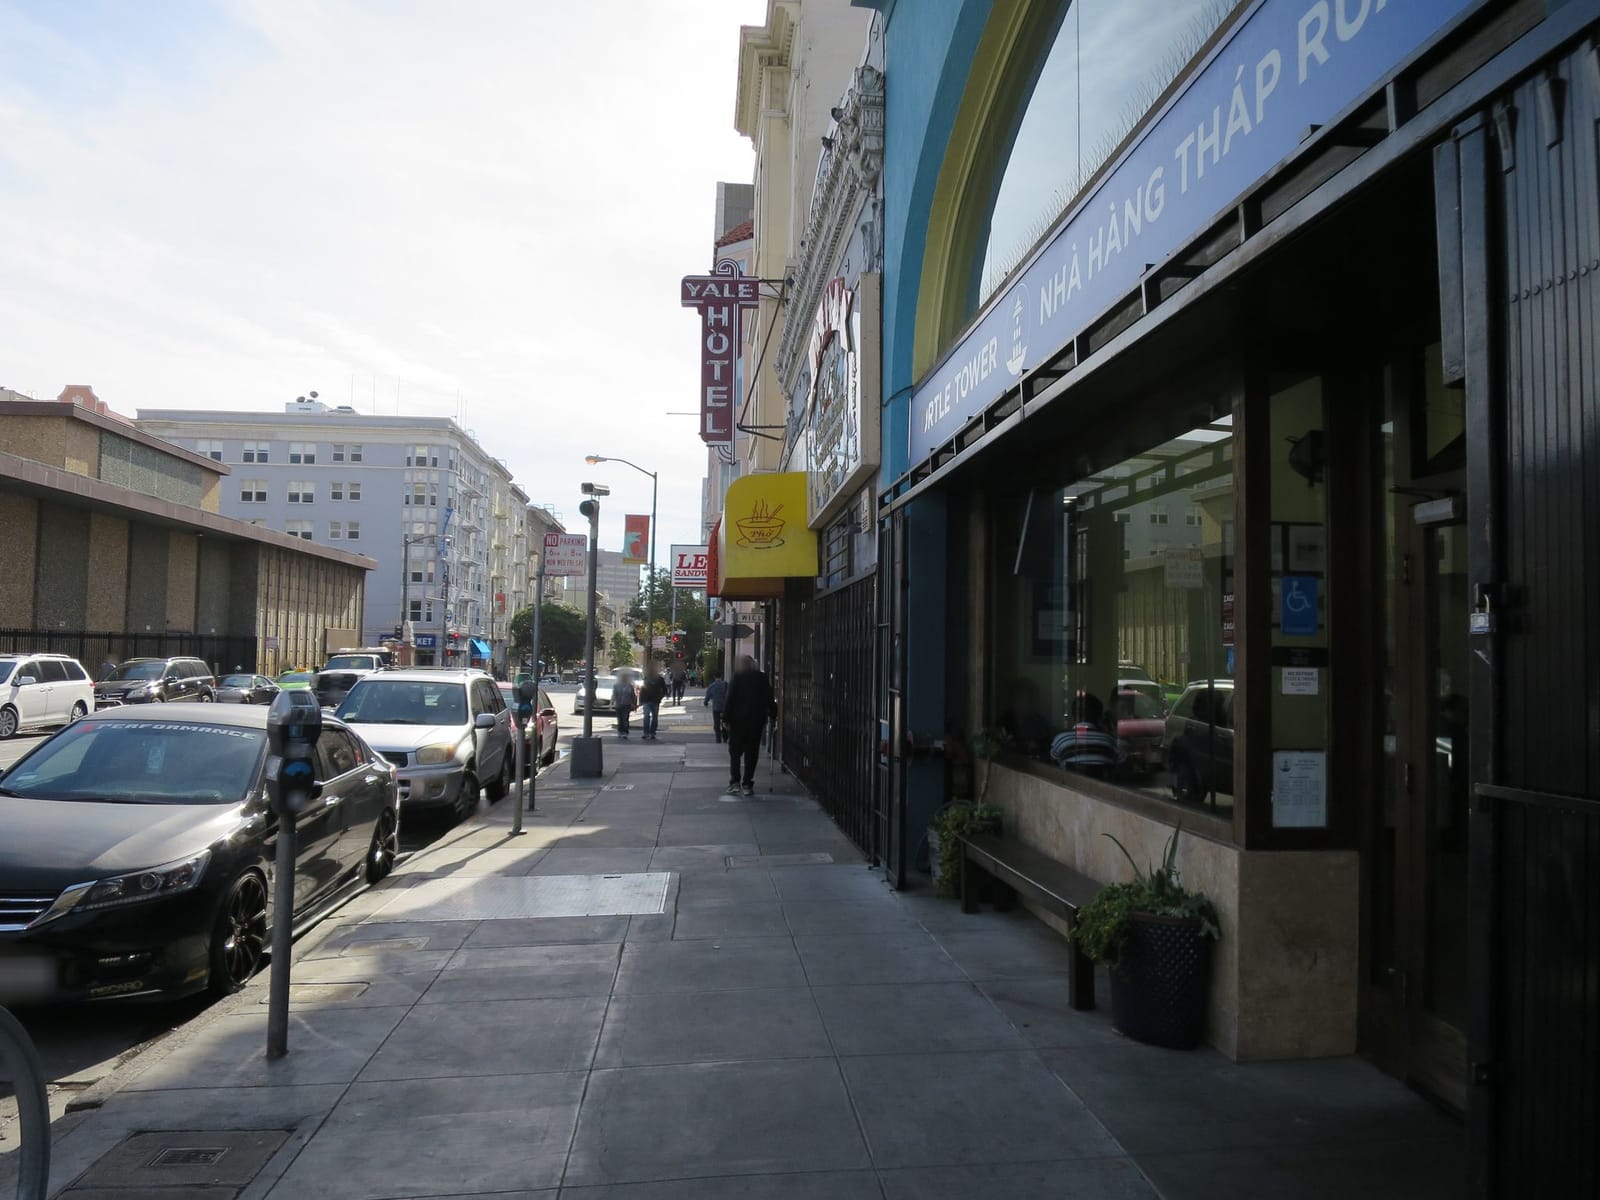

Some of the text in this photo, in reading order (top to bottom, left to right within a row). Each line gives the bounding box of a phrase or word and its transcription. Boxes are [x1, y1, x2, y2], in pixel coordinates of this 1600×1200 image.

[1174, 49, 1281, 194] THÁP
[685, 282, 754, 298] YALE
[706, 306, 729, 434] HOTEL
[954, 336, 997, 403] TOWER
[546, 535, 585, 546] NO PARKING
[676, 553, 708, 569] LE
[416, 637, 433, 646] KET
[97, 722, 257, 740] PERFORMANCE
